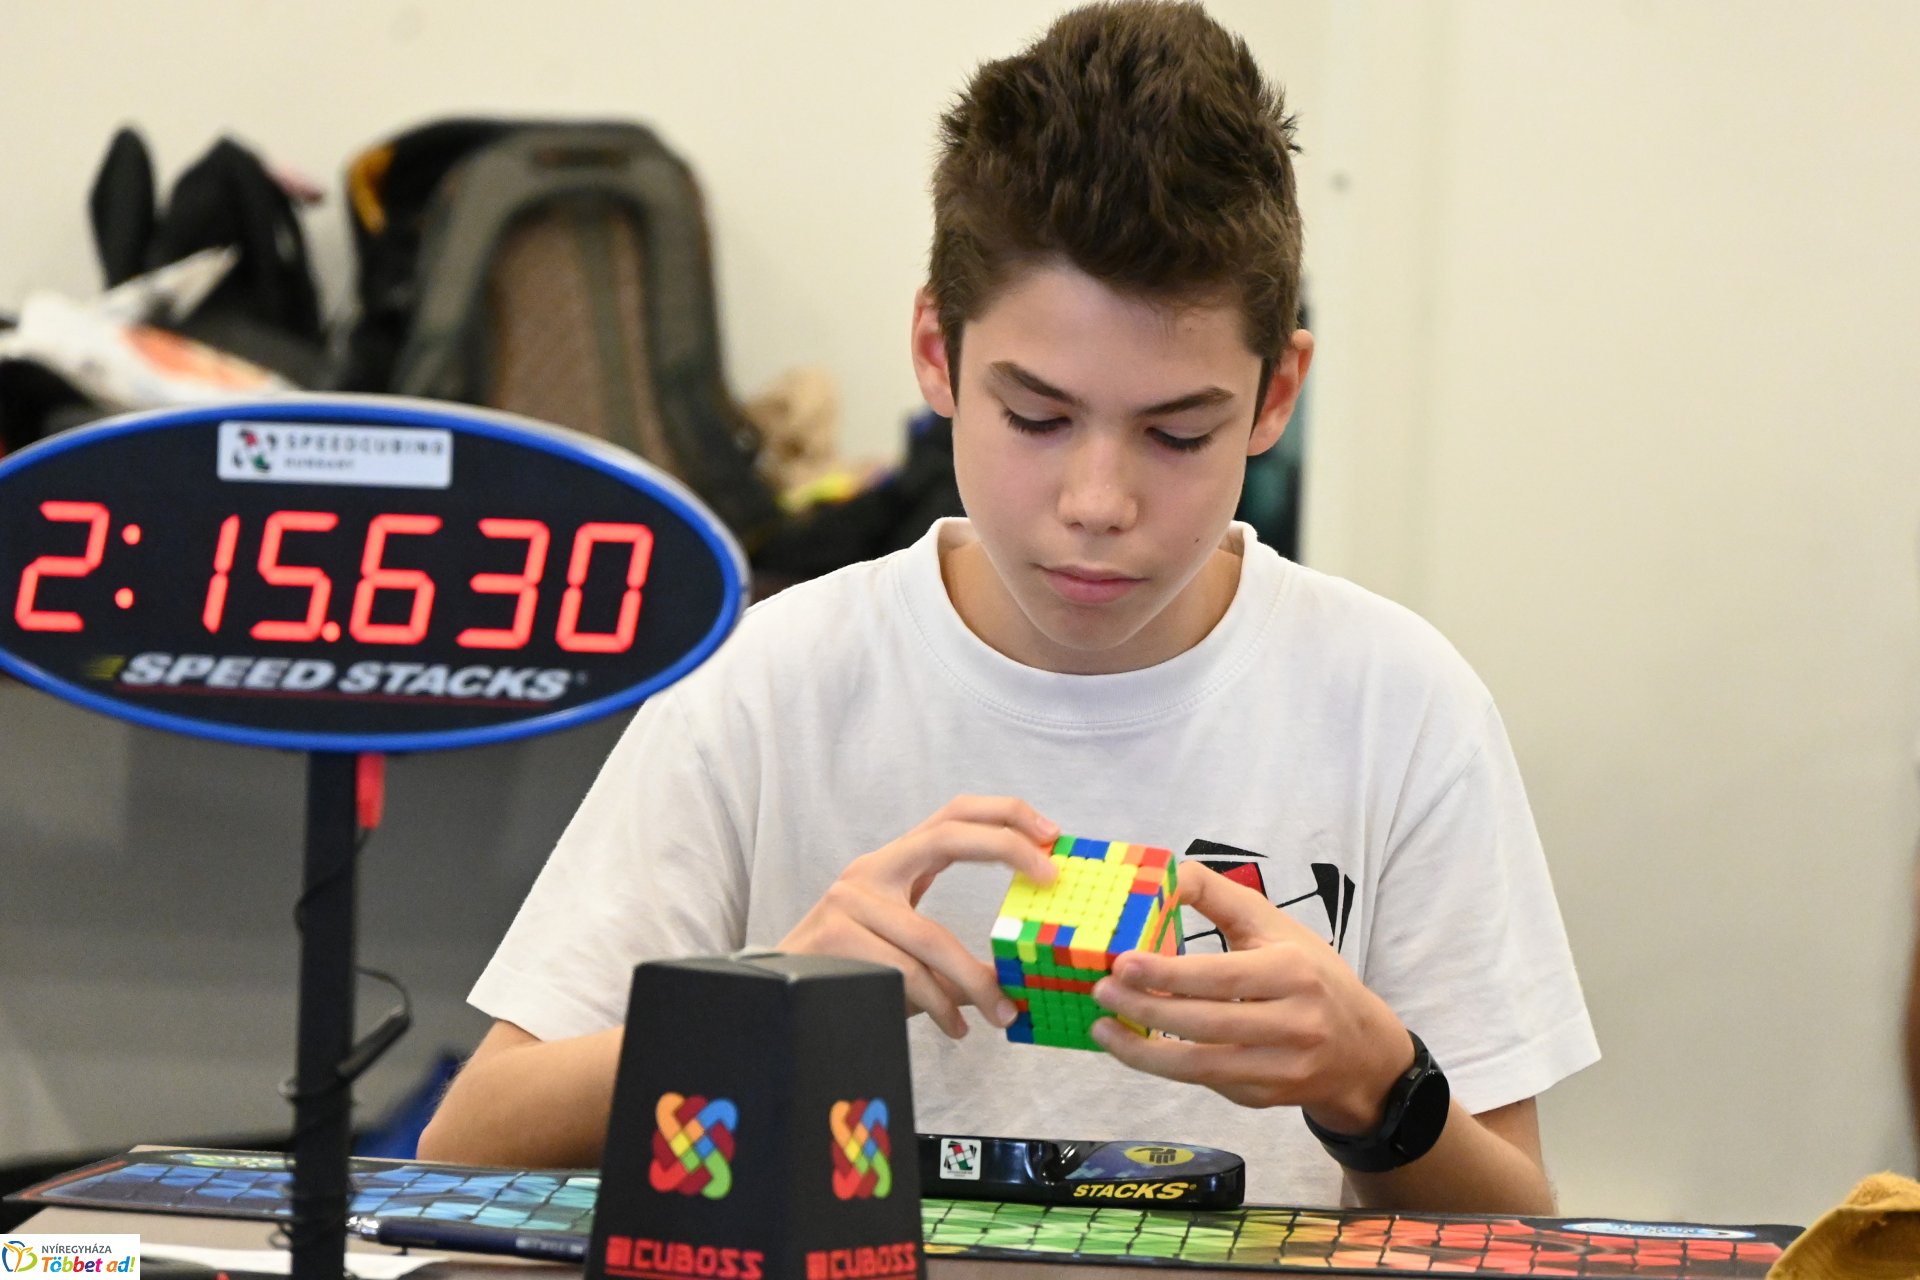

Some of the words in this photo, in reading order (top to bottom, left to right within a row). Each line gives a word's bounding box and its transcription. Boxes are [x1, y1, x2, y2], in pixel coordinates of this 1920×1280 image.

[120, 652, 337, 690] SPEED
[338, 660, 573, 700] STACKS
[1073, 1182, 1189, 1199] STACKS
[633, 1238, 764, 1279] CUBOSS
[831, 1242, 917, 1275] CUBOSS
